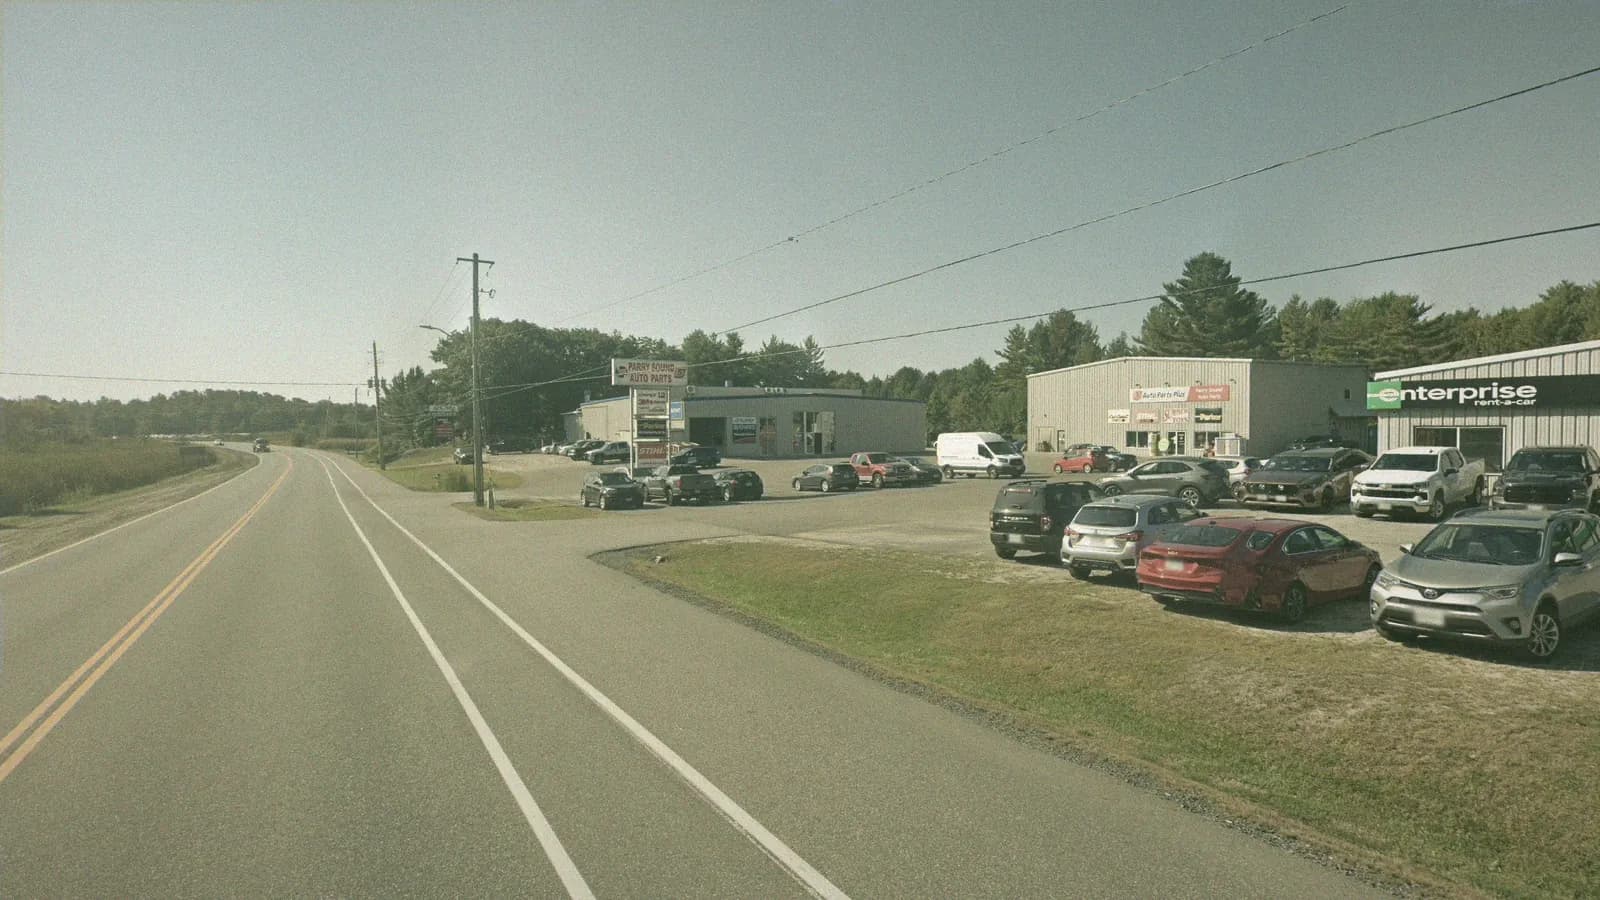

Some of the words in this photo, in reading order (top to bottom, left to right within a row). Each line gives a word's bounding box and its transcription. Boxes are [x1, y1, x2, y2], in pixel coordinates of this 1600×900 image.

[628, 362, 650, 371] PARRY
[652, 362, 675, 372] SOUND
[630, 373, 649, 383] AUTO
[651, 374, 673, 384] PARTS
[1143, 391, 1156, 399] Auto
[1157, 390, 1172, 398] Parts
[1174, 390, 1185, 398] Plus
[1379, 382, 1537, 403] enterprise
